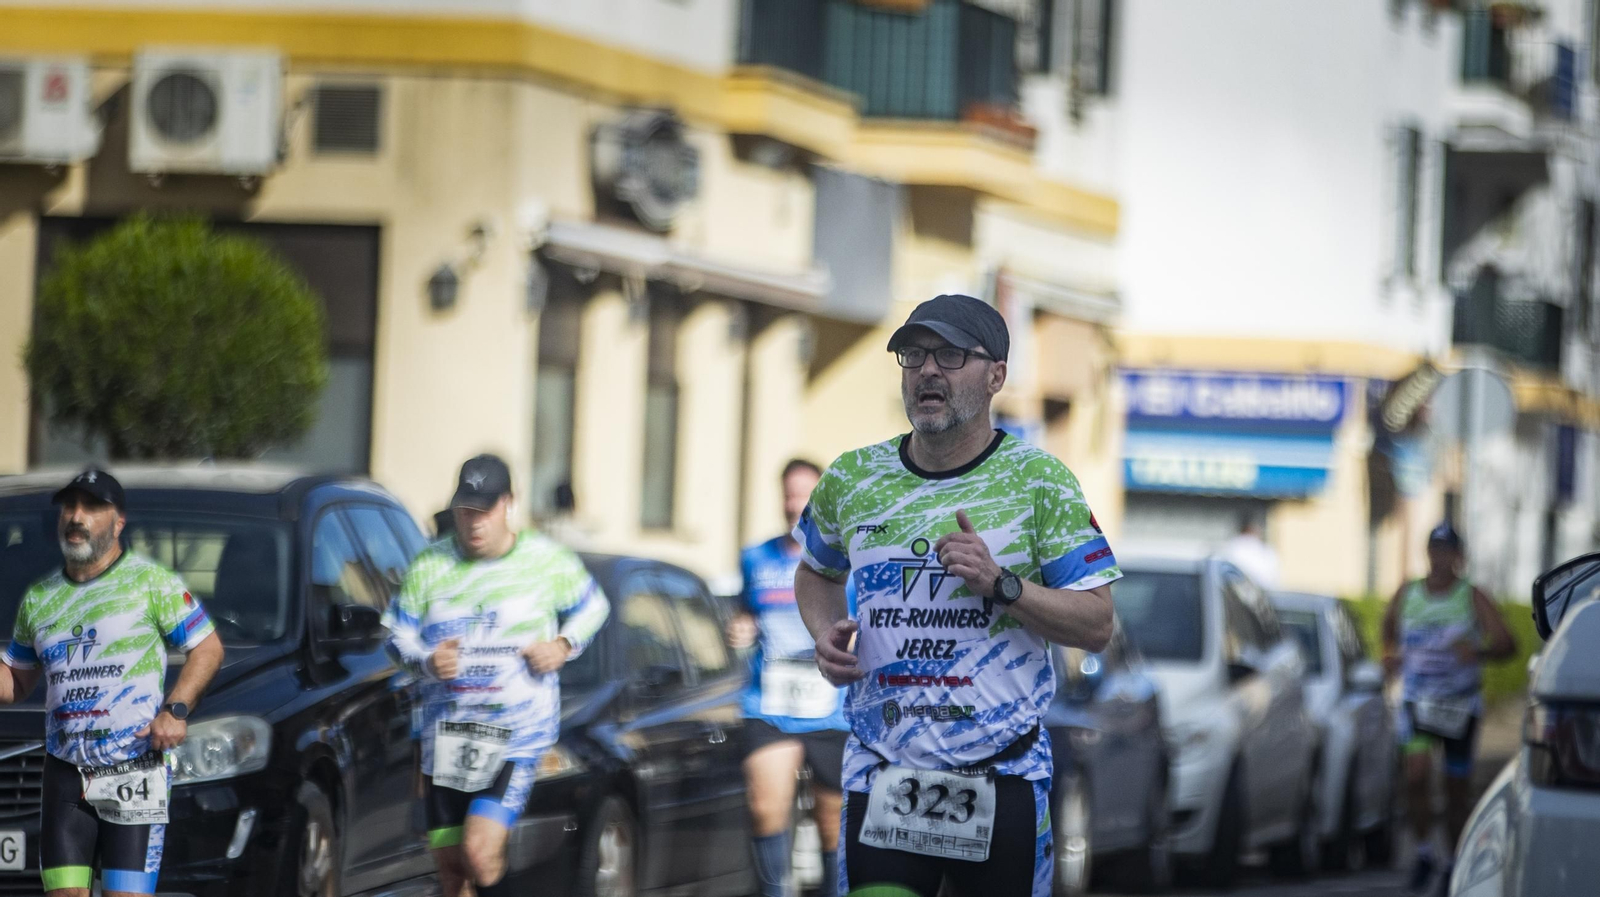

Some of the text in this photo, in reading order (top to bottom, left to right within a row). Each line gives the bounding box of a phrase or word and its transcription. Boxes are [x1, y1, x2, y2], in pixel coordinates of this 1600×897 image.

[869, 608, 990, 629] VETE-RUNNERS
[896, 638, 957, 660] JEREZ
[62, 686, 99, 703] JEREZ
[116, 777, 149, 802] 64
[893, 777, 977, 824] 323
[864, 828, 894, 844] enjoy!
